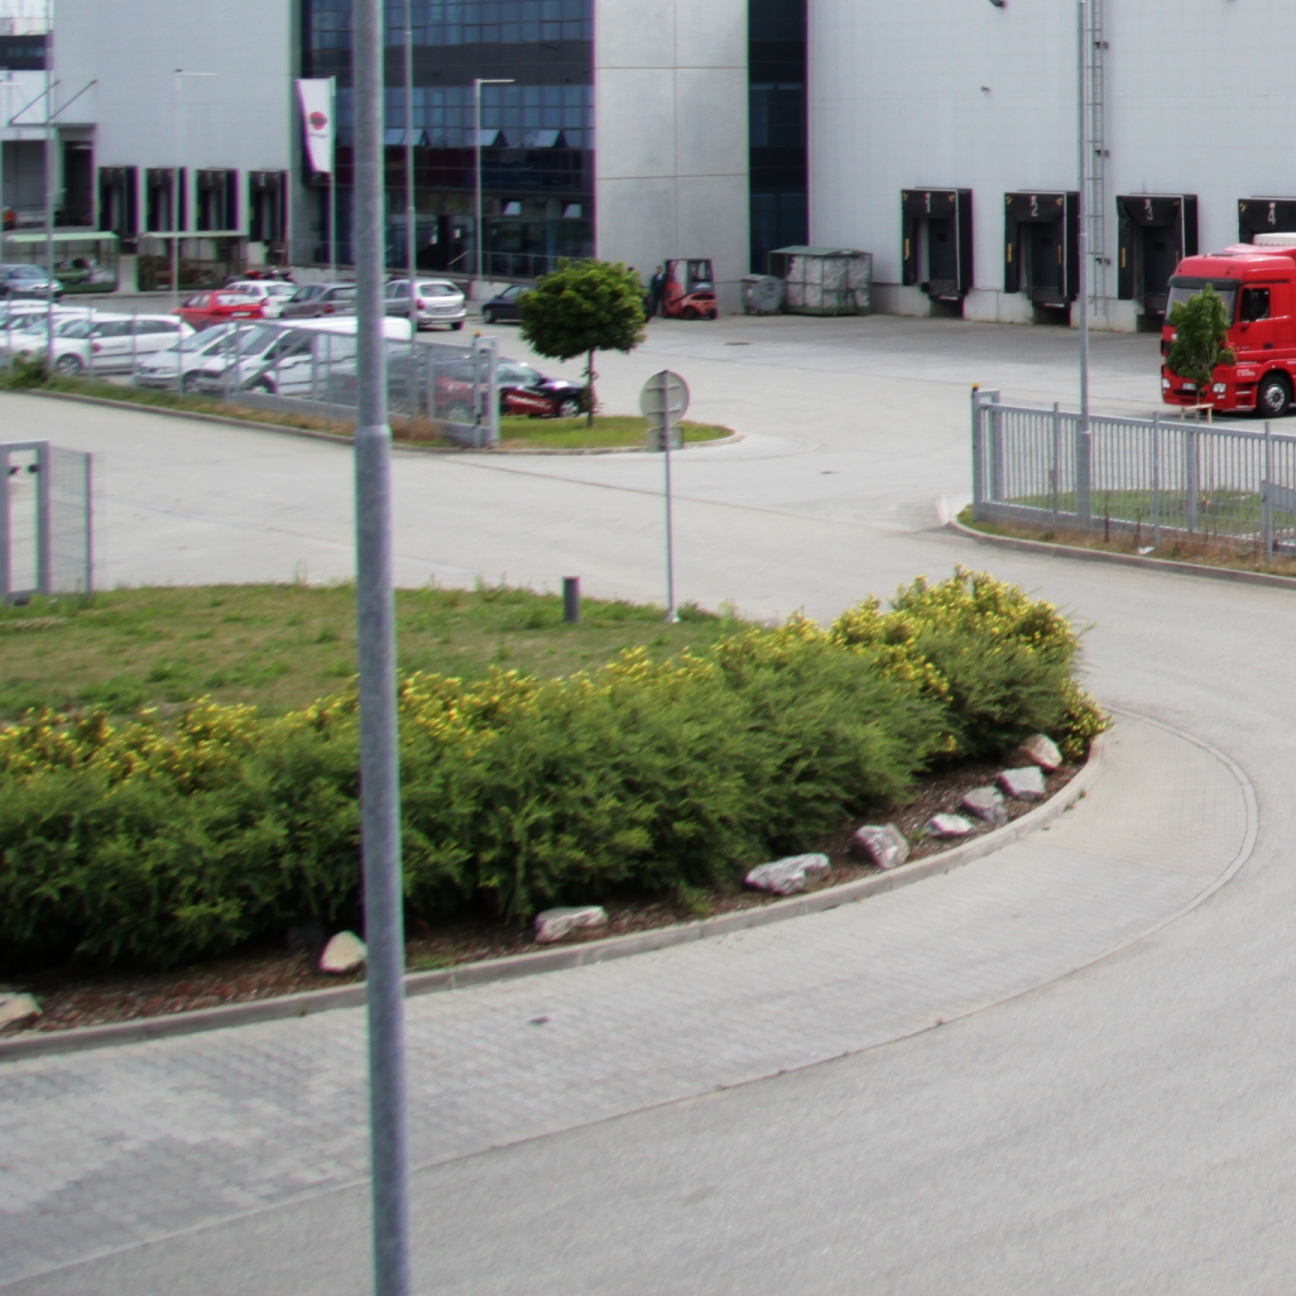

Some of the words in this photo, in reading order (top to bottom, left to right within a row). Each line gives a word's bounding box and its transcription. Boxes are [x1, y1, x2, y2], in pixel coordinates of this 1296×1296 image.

[924, 199, 931, 213] 1
[1031, 202, 1038, 216] 2
[1145, 204, 1153, 220] 3
[1268, 208, 1276, 225] 4
